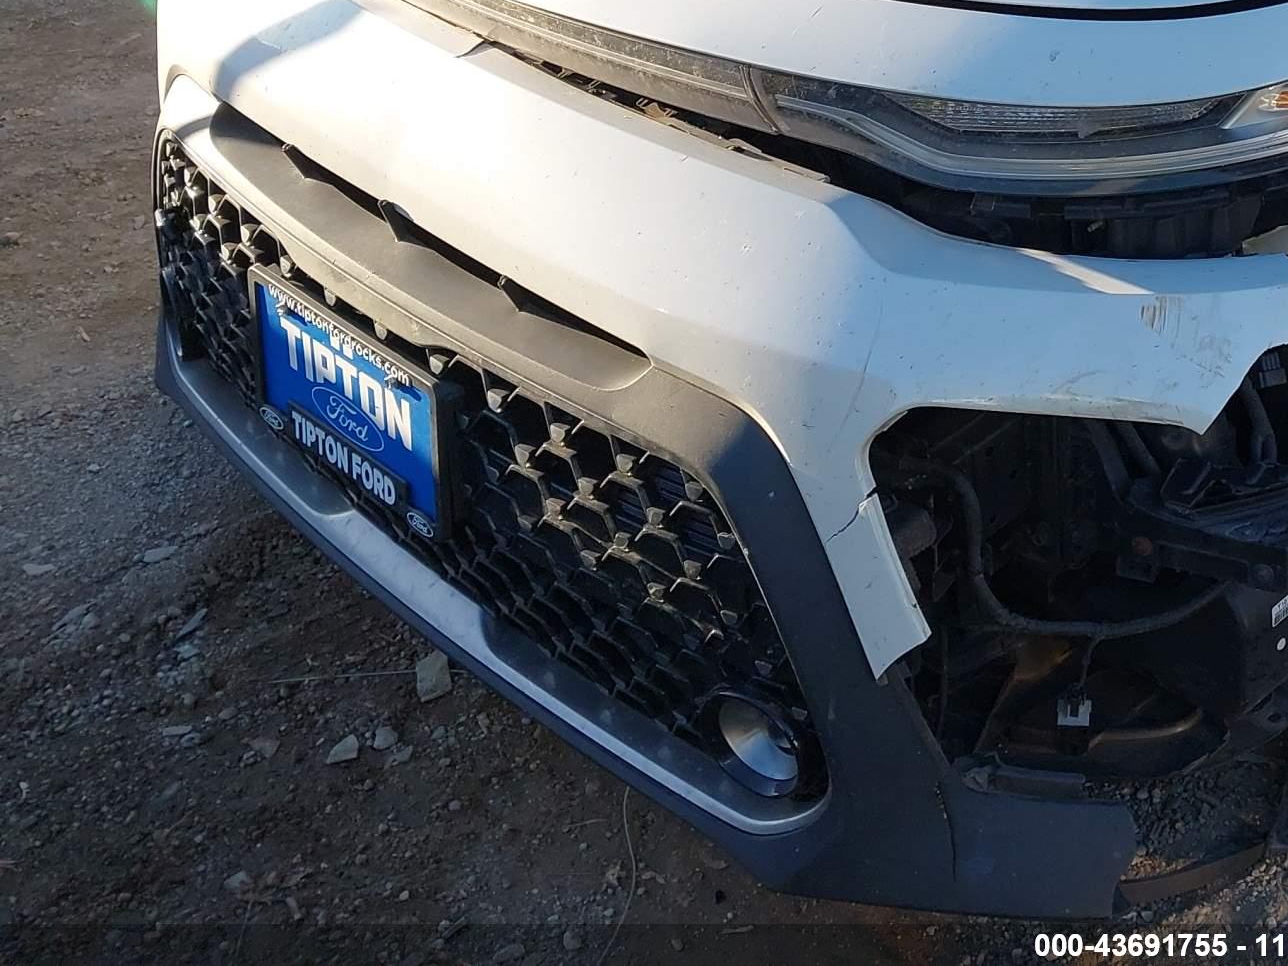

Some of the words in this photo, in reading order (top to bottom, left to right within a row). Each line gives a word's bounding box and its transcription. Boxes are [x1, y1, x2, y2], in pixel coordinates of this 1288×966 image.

[268, 284, 409, 387] www.tiptonfordrocks.com
[280, 317, 413, 451] TIPTON
[291, 411, 349, 474] TIPTON
[352, 451, 396, 506] FORD
[327, 397, 369, 443] Ford
